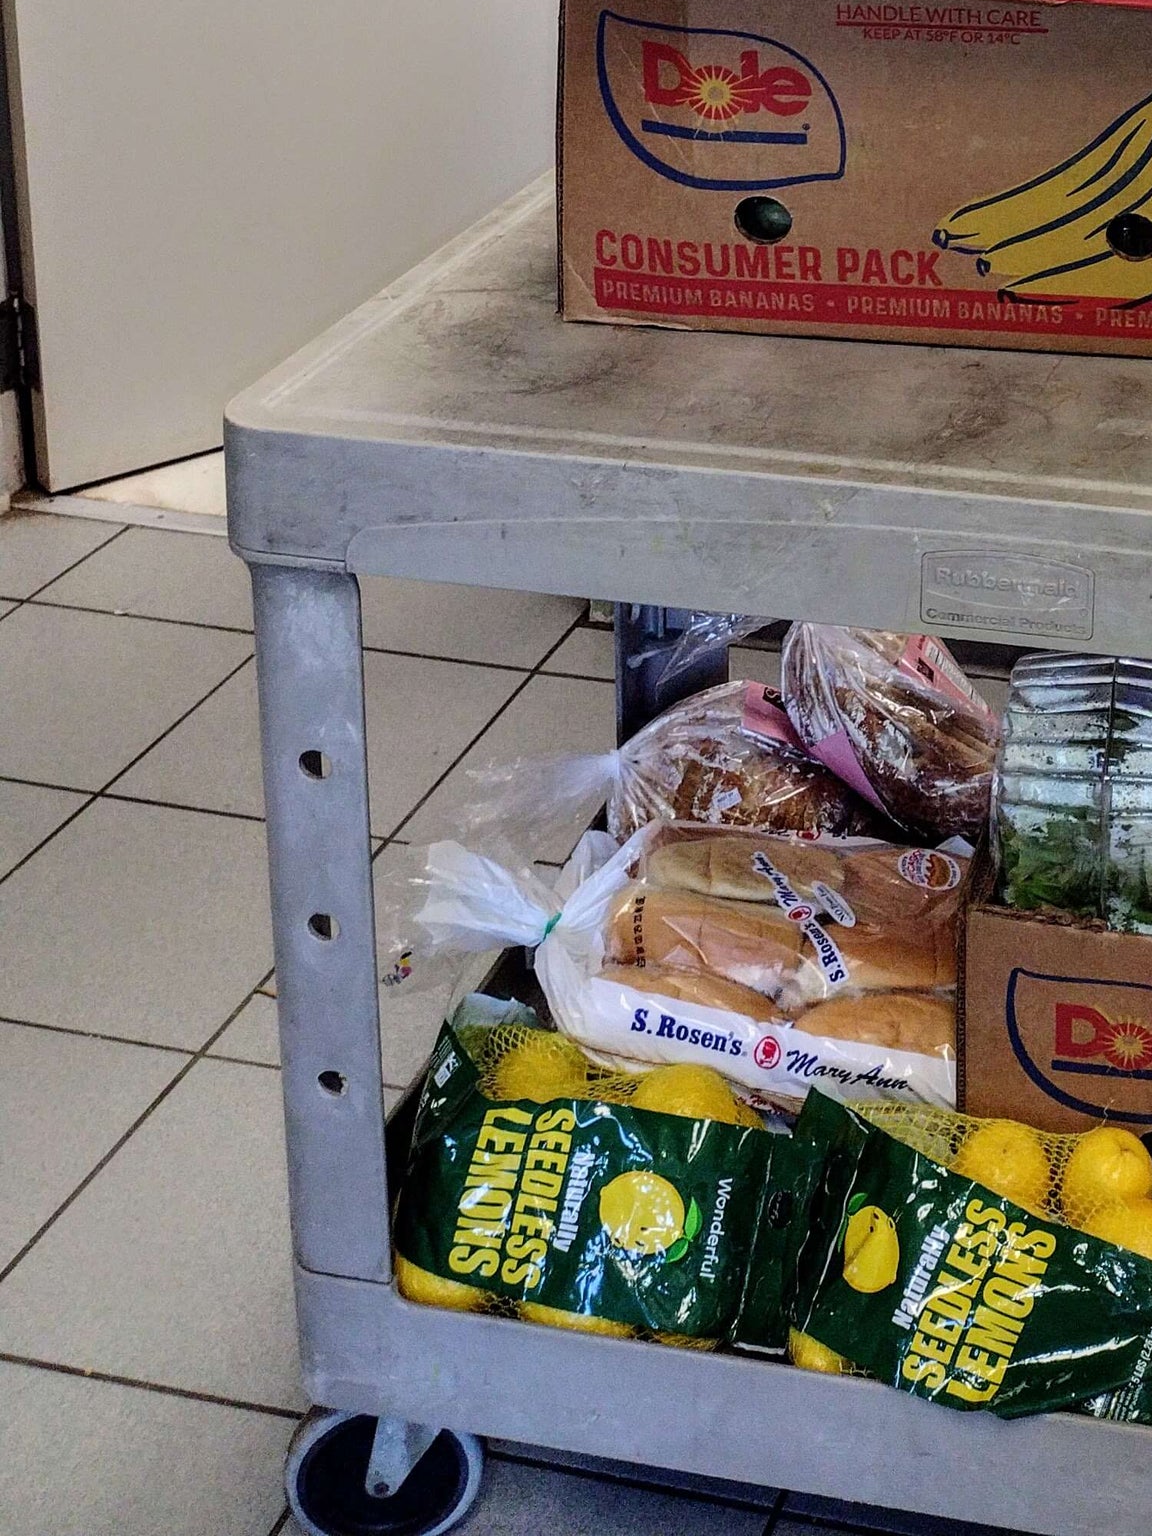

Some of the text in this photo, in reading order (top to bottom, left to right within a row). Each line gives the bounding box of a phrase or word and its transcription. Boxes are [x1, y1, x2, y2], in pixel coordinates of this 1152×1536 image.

[836, 4, 1041, 27] HANDLE WITH CARE
[863, 28, 897, 41] KEEP
[901, 28, 922, 41] AT
[961, 31, 984, 43] OR
[642, 41, 812, 120] Dole
[596, 229, 943, 287] CONSUMER PACK
[602, 279, 701, 306] PREMIUM
[709, 289, 815, 312] BANANAS
[847, 297, 951, 318] PREMIUM
[957, 301, 1064, 325] BANANAS
[934, 566, 1079, 598] Rubbermaid
[925, 607, 1088, 635] Commercial Products
[805, 919, 838, 967] Rosen's
[631, 1007, 909, 1091] S. Rosen's Mary Ann
[448, 1107, 534, 1278] LEMONS
[501, 1108, 577, 1290] SEEDLESS
[553, 1145, 597, 1253] Naturally
[699, 1177, 734, 1279] Wonderful
[891, 1223, 952, 1331] Naturally
[901, 1198, 1008, 1388] SEEDLESS
[946, 1221, 1057, 1403] LEMONS
[1131, 1376, 1141, 1385] 5
[1134, 1360, 1147, 1376] LBS
